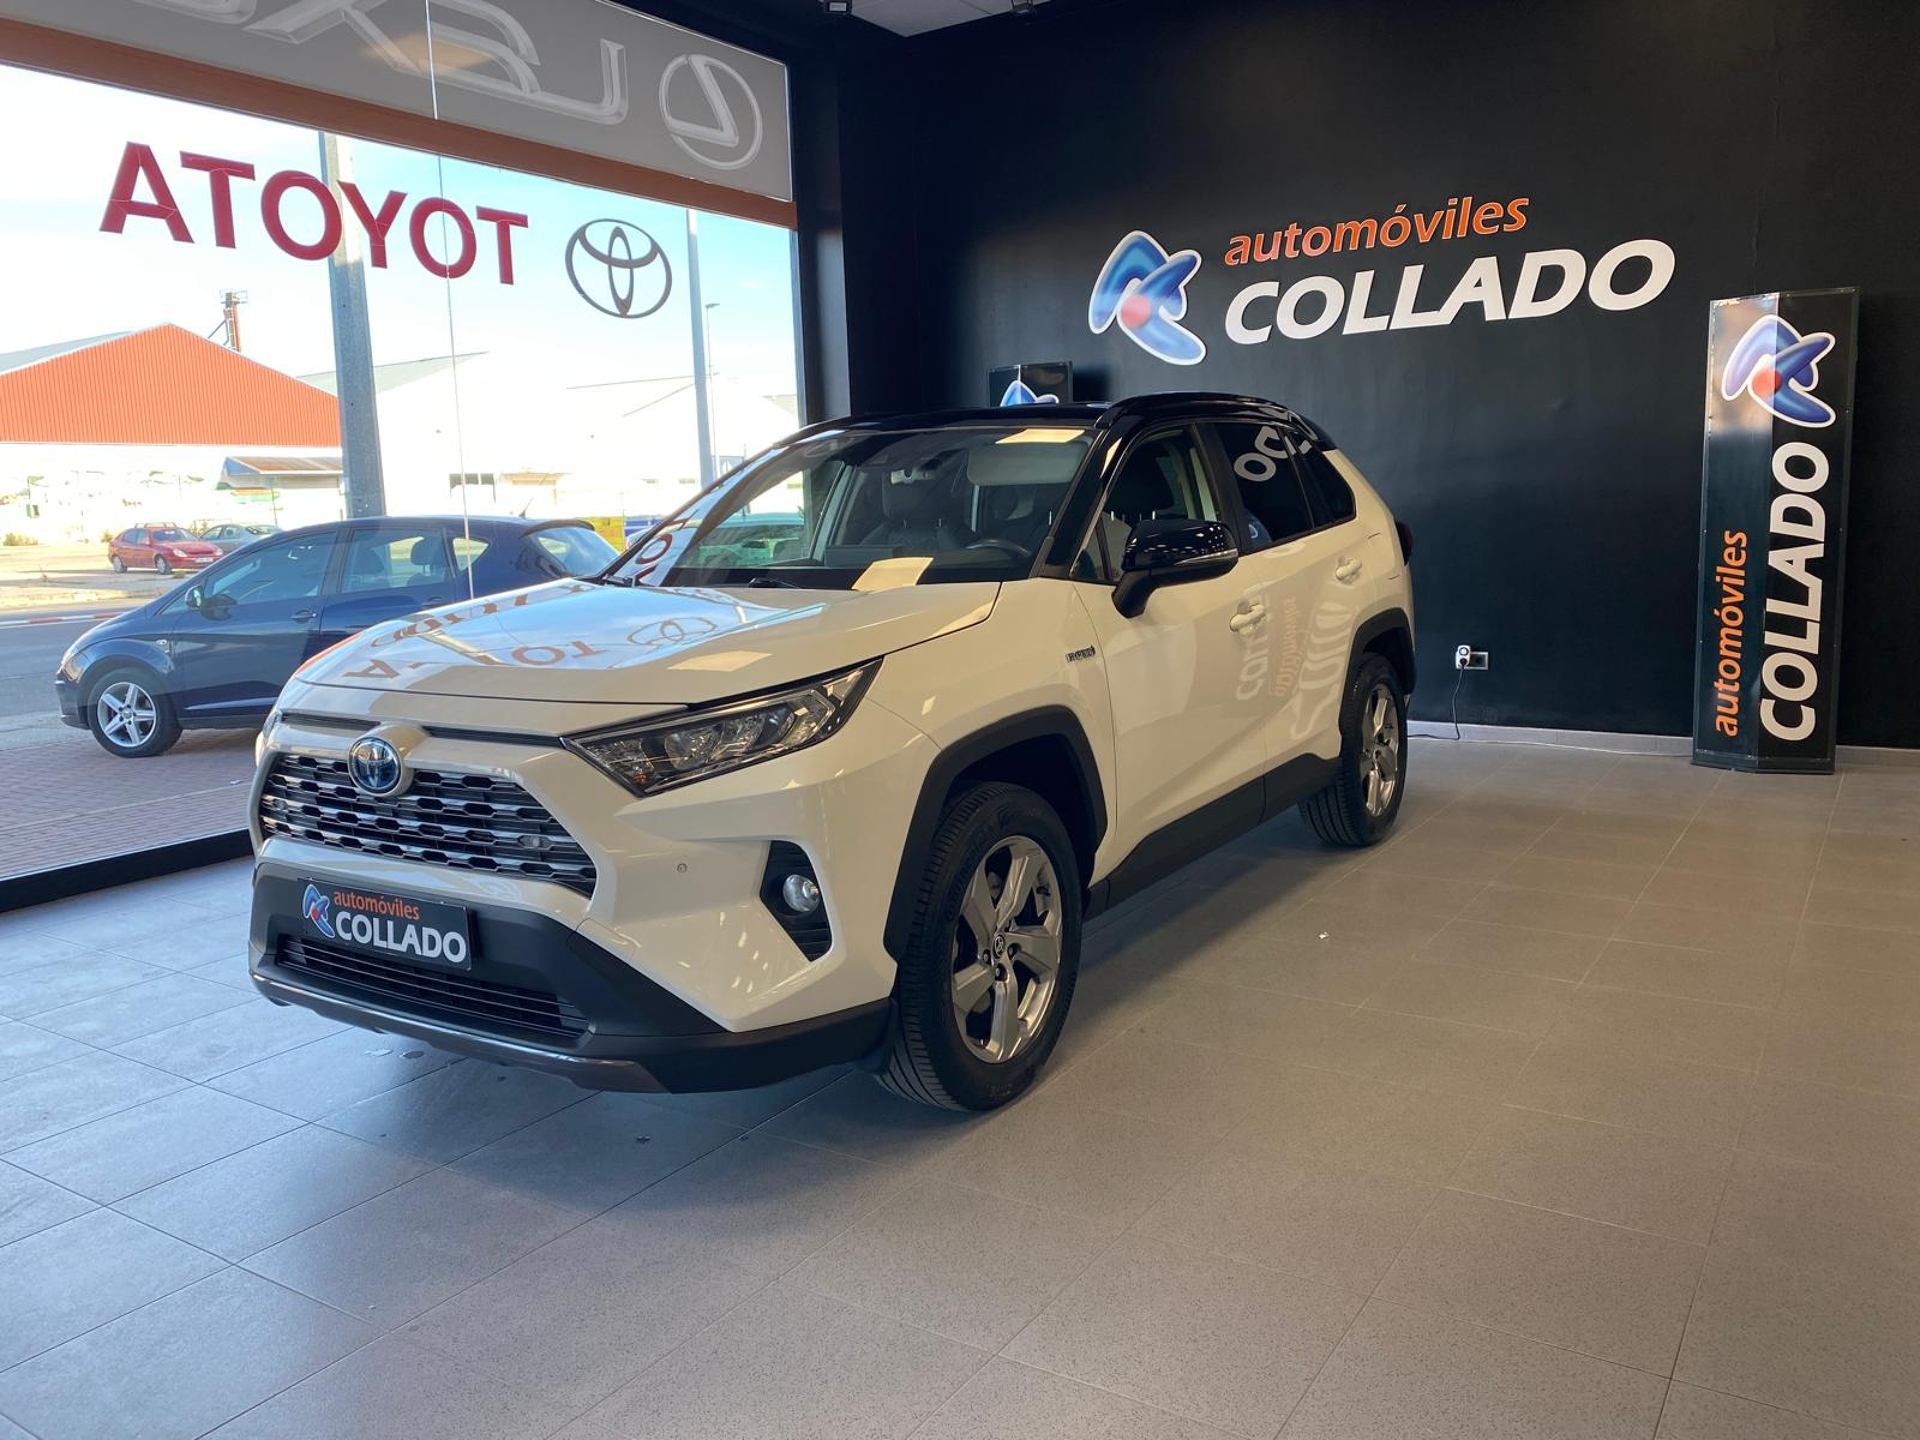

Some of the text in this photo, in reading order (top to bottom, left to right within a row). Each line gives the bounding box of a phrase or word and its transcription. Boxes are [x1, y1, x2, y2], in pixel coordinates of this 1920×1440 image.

[1224, 196, 1531, 267] automóviles
[1224, 239, 1677, 345] COLLADO
[1714, 530, 1749, 738] automóviles
[1760, 442, 1831, 743] COLLADO
[334, 890, 421, 921] automóviles
[335, 911, 467, 963] COLLADO
